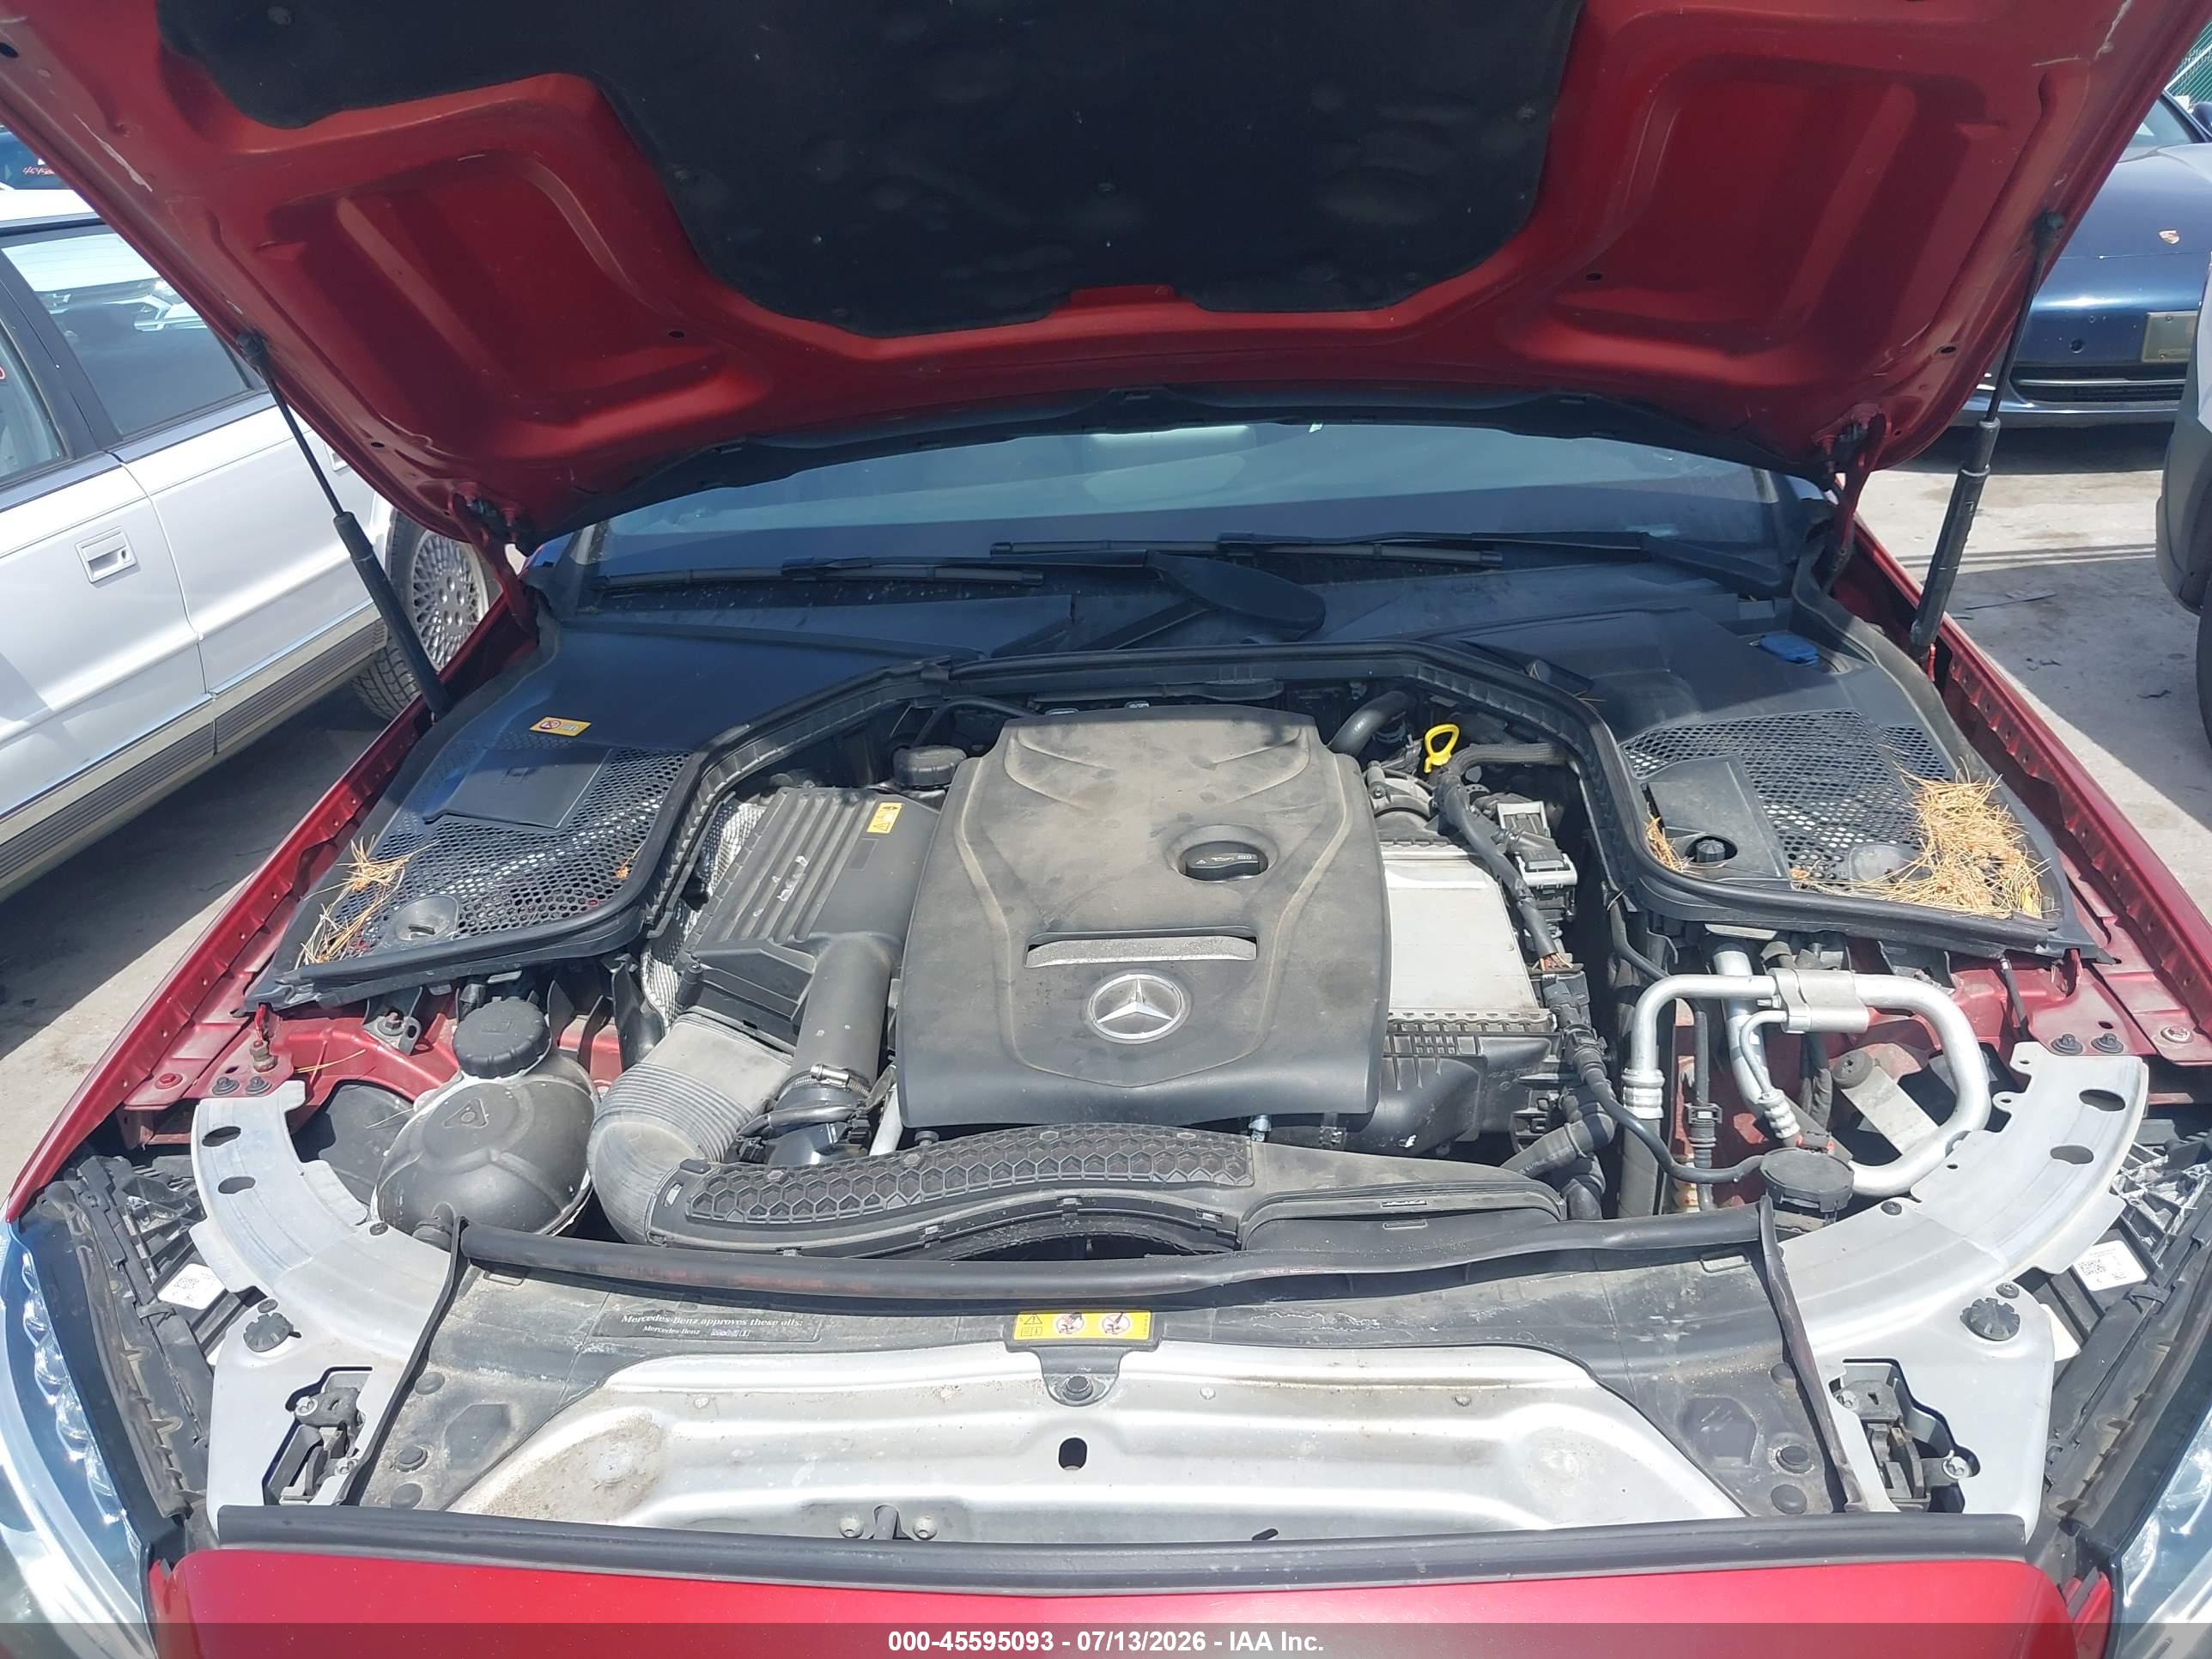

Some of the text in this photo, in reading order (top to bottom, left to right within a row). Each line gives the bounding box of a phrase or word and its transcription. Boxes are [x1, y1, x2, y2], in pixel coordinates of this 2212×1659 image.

[621, 1314, 700, 1326] Mercedes-Benz
[700, 1318, 749, 1327] approves
[750, 1318, 779, 1327] these
